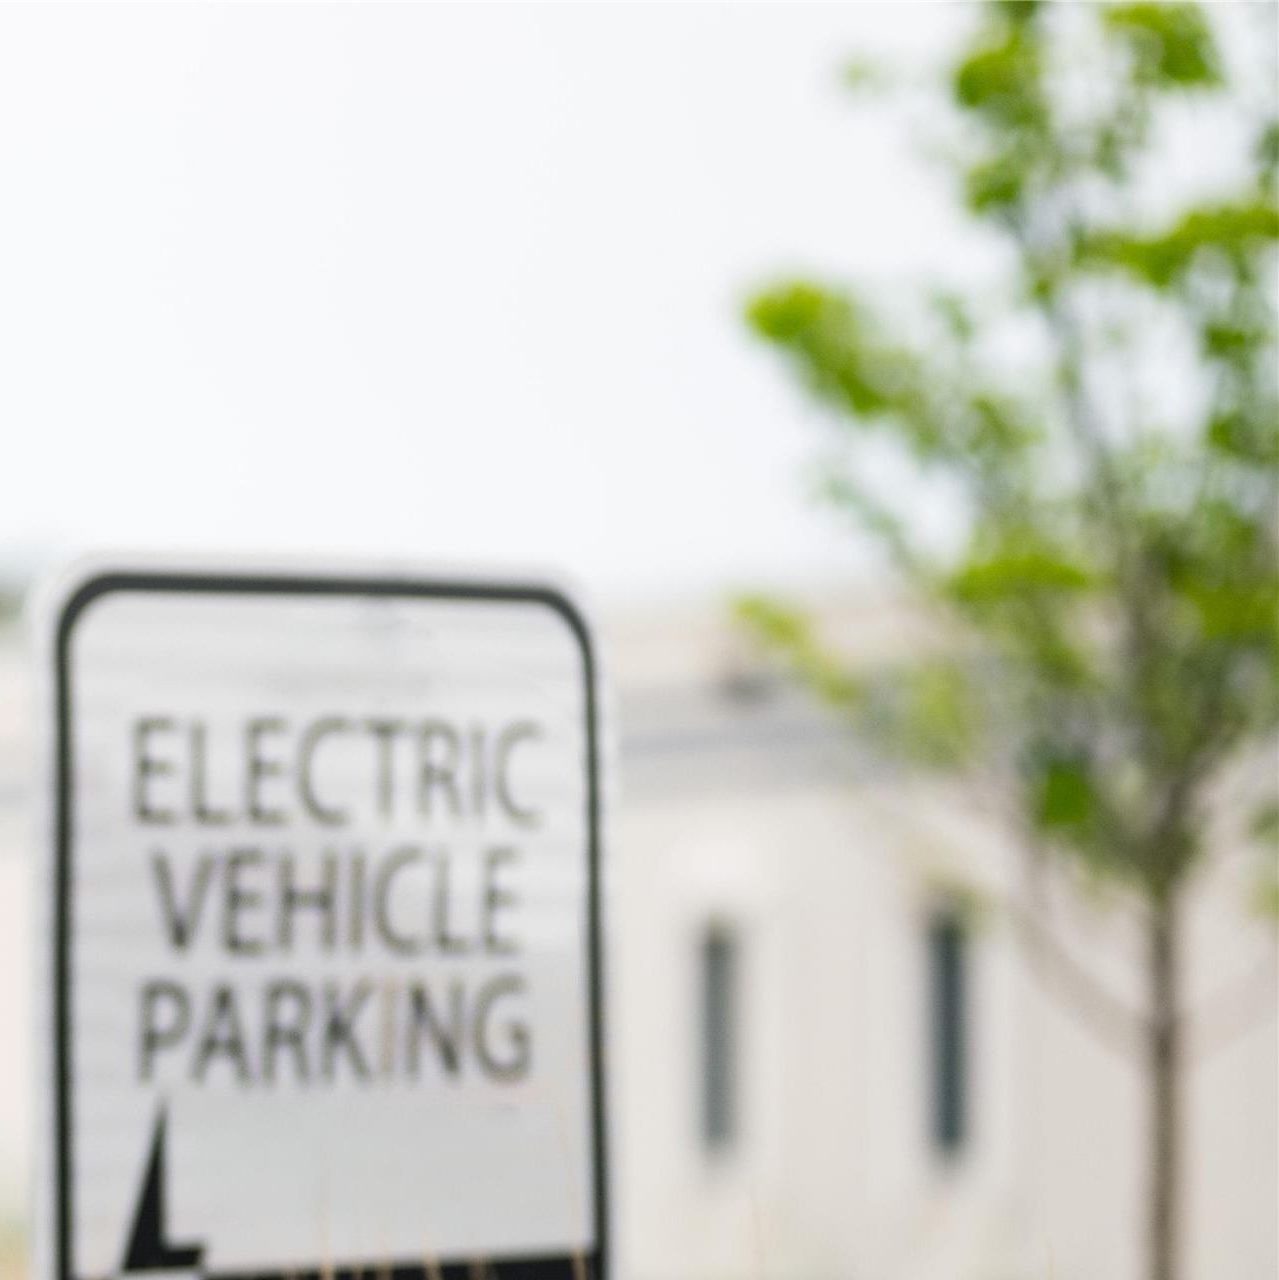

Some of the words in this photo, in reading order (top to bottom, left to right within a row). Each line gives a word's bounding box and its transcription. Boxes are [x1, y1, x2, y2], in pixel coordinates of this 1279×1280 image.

[130, 716, 543, 830] ELECTRIC
[149, 844, 523, 957] VEHICLE
[137, 974, 533, 1086] PARKING
